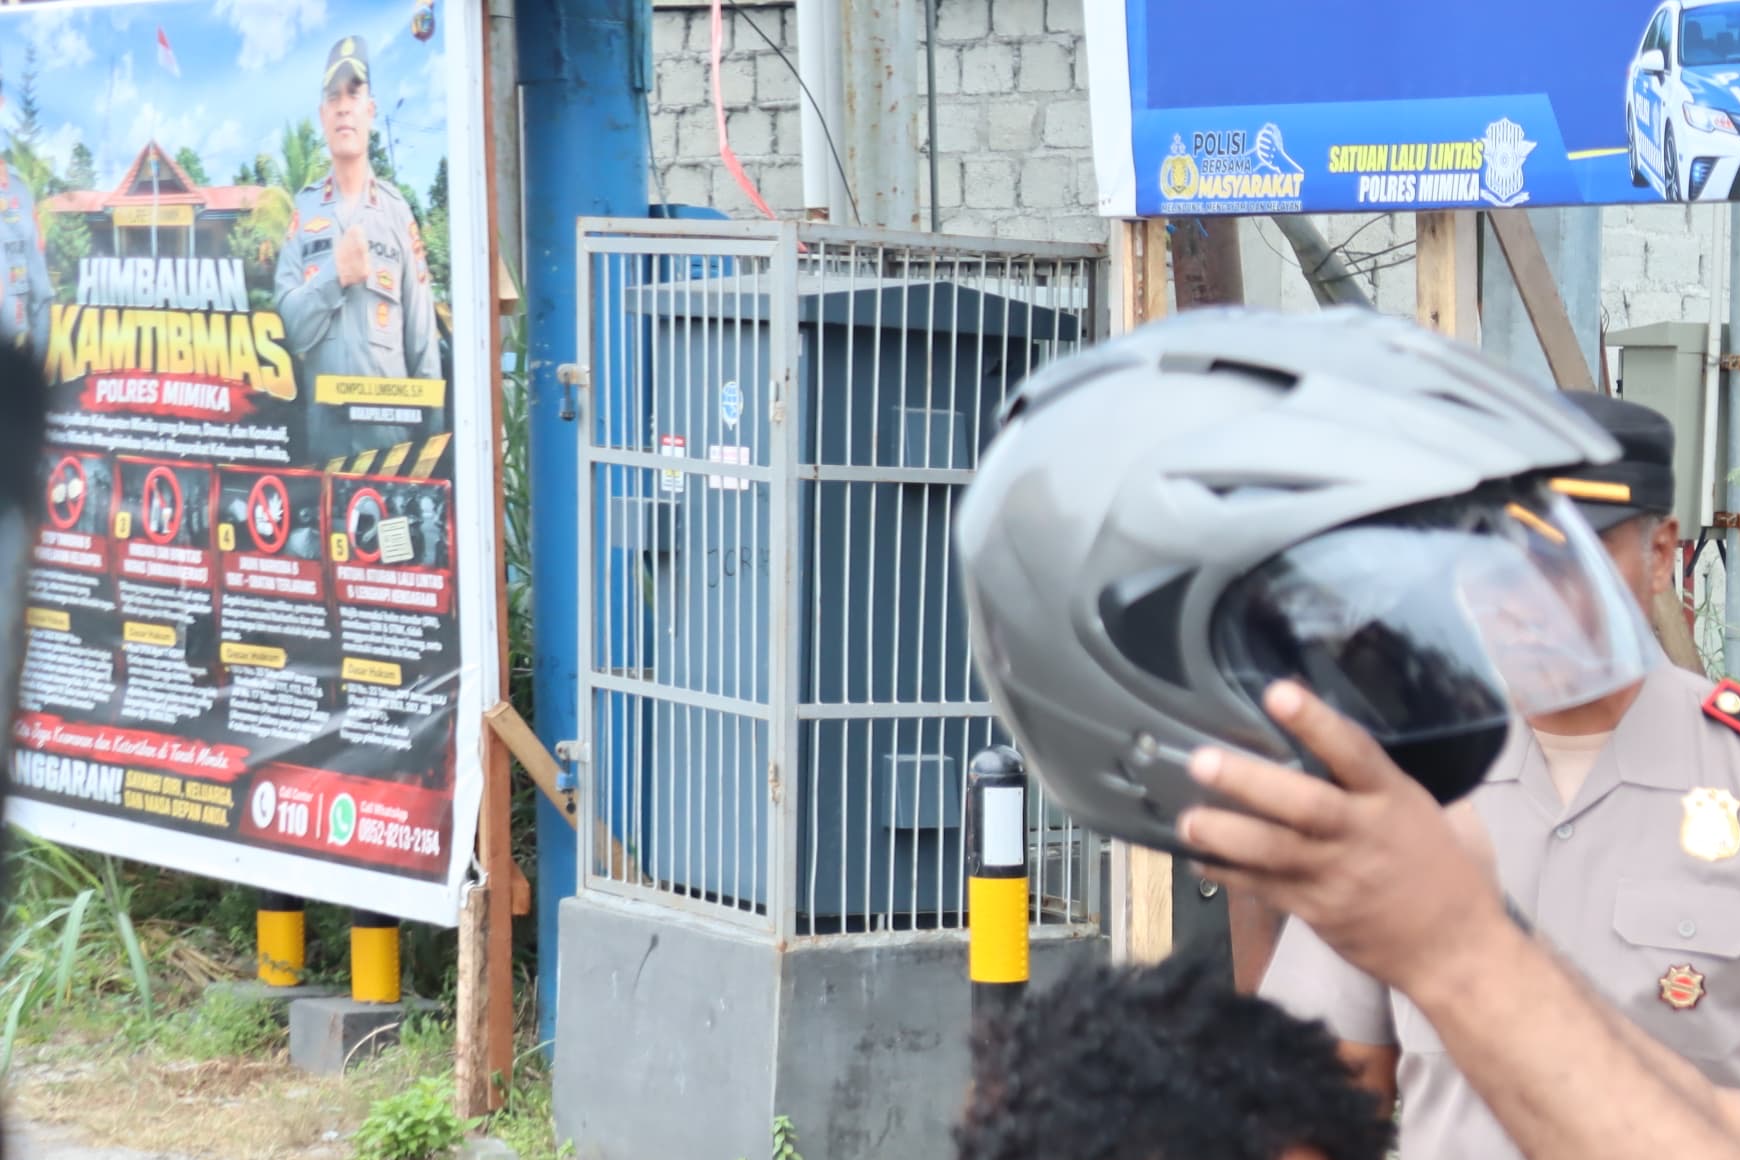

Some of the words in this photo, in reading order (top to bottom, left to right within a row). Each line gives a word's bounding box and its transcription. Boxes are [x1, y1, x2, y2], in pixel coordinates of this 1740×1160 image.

[1193, 131, 1247, 156] POLISI
[1329, 143, 1388, 173] SATUAN
[1390, 142, 1428, 172] LALU
[1429, 141, 1484, 171] LINTAS
[1202, 158, 1253, 174] BERSAMA
[1198, 173, 1305, 199] MASYARAKAT
[1359, 174, 1417, 203] POLRES
[1418, 172, 1480, 202] MIMIKA
[77, 256, 250, 312] HIMBAUAN
[43, 304, 298, 402] KAMTIBMAS
[95, 379, 159, 404] POLRES
[162, 381, 232, 413] MIMIKA
[277, 800, 309, 837] 110
